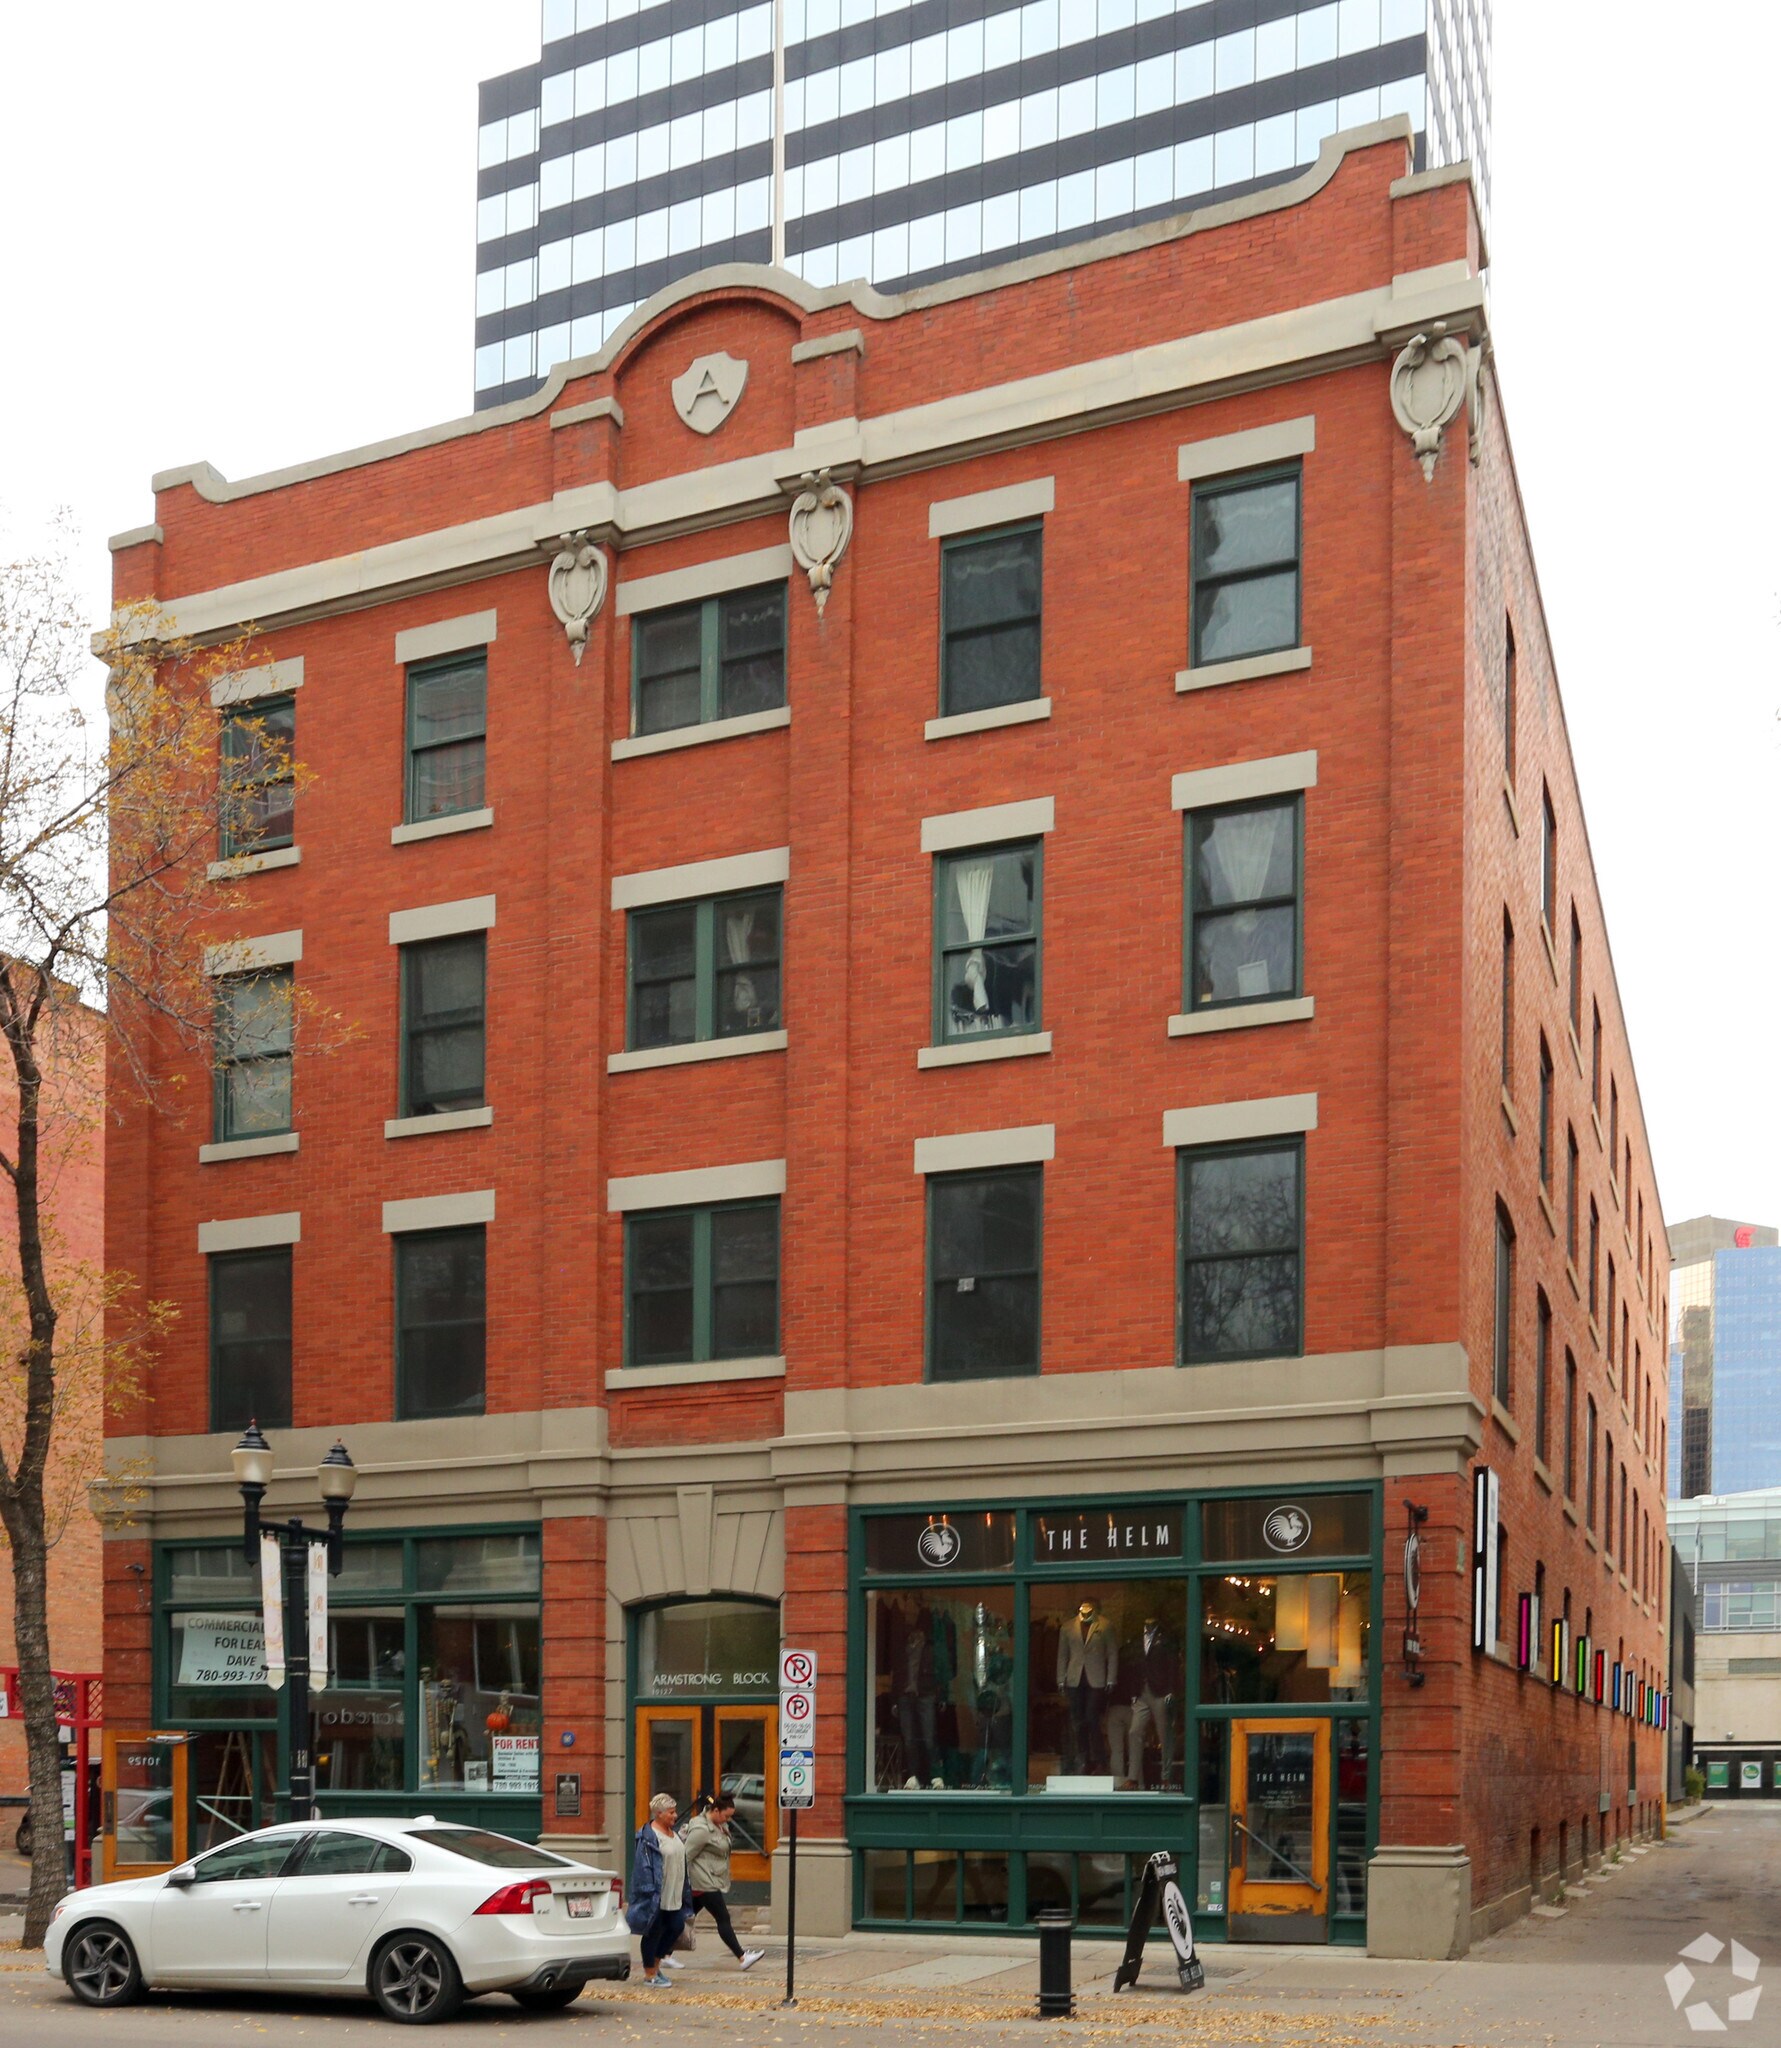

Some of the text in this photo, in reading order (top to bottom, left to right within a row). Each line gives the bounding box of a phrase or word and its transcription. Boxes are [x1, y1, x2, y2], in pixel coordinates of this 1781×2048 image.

[685, 362, 730, 415] A
[1047, 1525, 1169, 1551] THE HELM
[214, 1637, 266, 1651] FOR LEAS
[226, 1655, 257, 1667] DAVE
[792, 1658, 806, 1677] P
[196, 1669, 268, 1682] 780-993-191
[652, 1671, 770, 1686] ARMSTRONG BLOCK
[793, 1700, 804, 1715] P
[494, 1739, 539, 1750] FOR RENT
[793, 1771, 802, 1782] P
[1256, 1773, 1305, 1782] THE HELM
